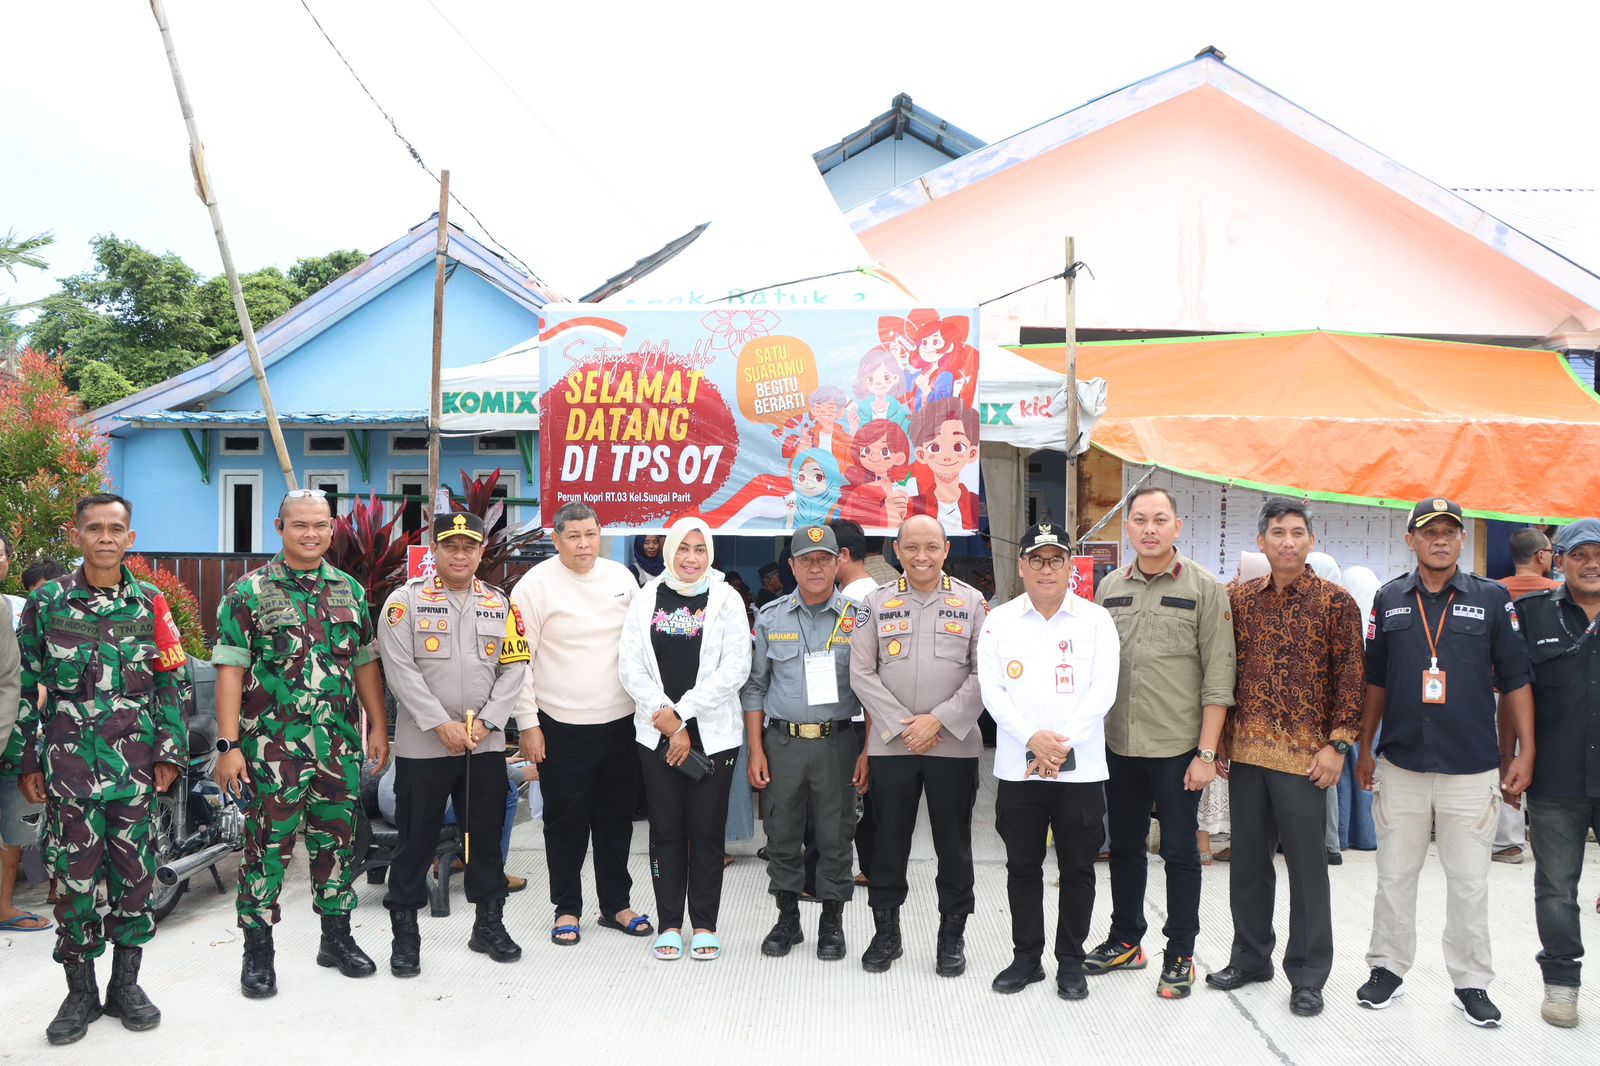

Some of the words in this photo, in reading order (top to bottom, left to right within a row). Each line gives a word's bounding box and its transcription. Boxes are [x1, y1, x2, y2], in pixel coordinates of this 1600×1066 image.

[755, 344, 788, 364] SATU
[744, 359, 805, 383] SUARAMU
[565, 370, 704, 404] SELAMAT
[755, 377, 798, 398] BEGITU
[442, 391, 539, 414] KOMIX
[754, 391, 806, 415] BERARTI
[1020, 396, 1052, 417] kid
[565, 408, 690, 441] DATANG
[561, 445, 598, 482] DI
[611, 445, 671, 482] TPS
[678, 445, 723, 485] 07
[557, 492, 581, 502] Perum
[584, 492, 603, 504] Kopri
[605, 492, 627, 502] RT.03
[672, 492, 691, 502] Parit
[476, 611, 504, 619] POLRI
[938, 610, 968, 620] POLRI
[119, 625, 136, 634] TNI
[768, 632, 799, 640] MAKMUR
[501, 640, 515, 656] KA
